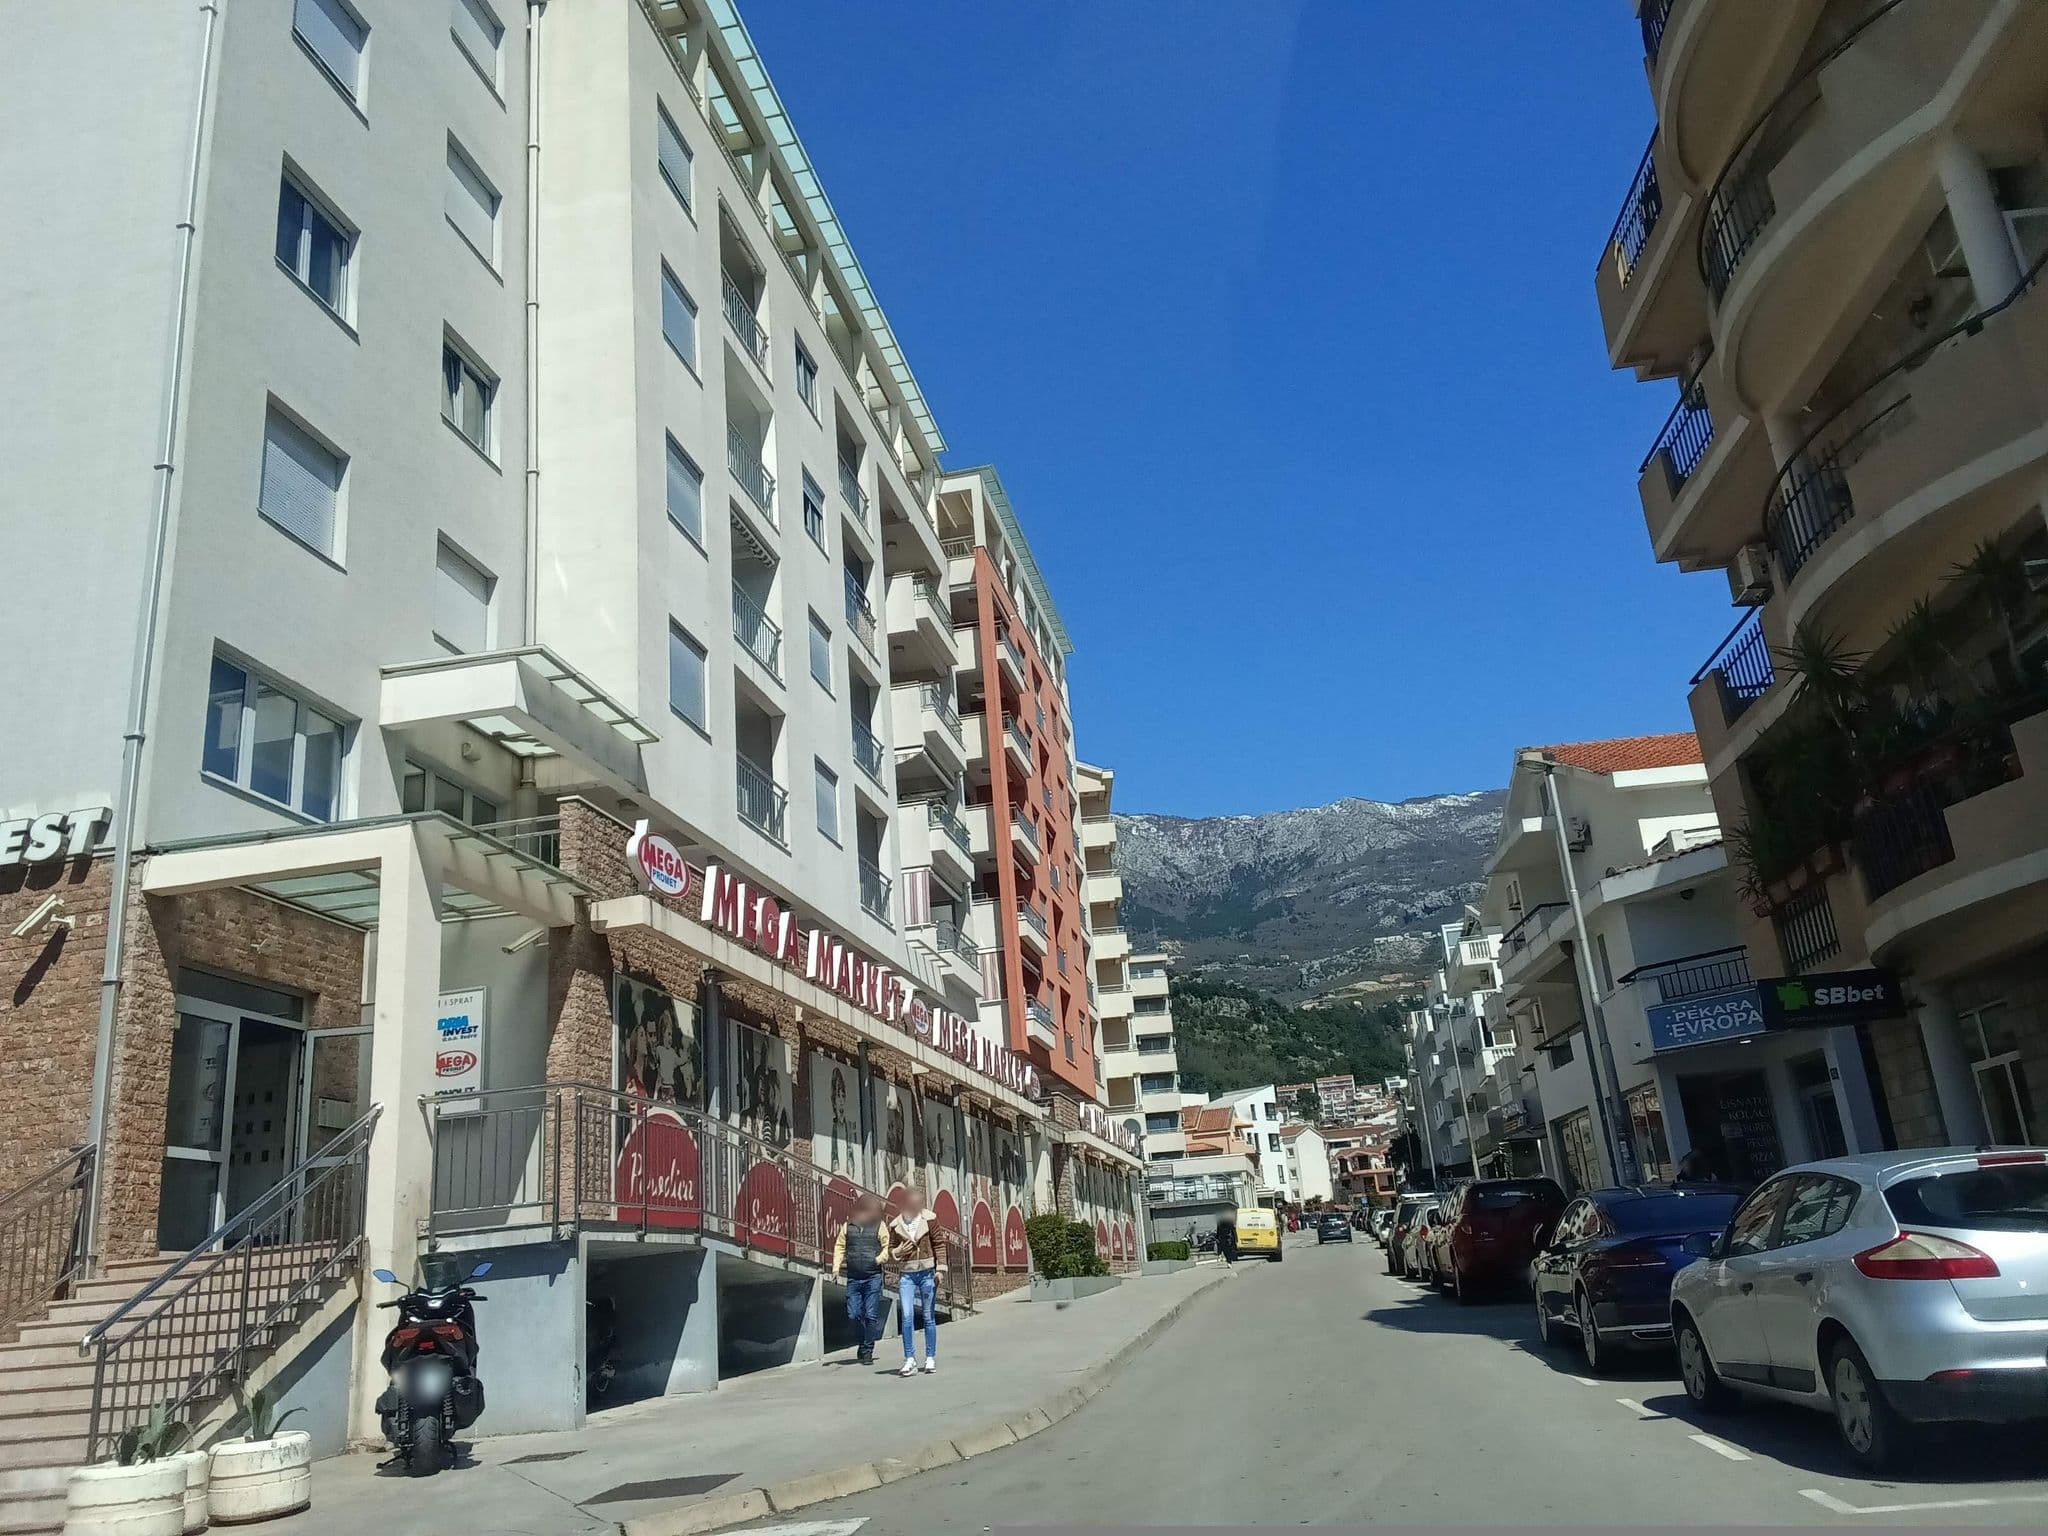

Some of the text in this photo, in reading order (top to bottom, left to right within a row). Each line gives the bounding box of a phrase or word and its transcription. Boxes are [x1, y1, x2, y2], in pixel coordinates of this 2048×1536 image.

[643, 842, 684, 882] MEGA
[652, 868, 678, 889] PROMET
[702, 865, 905, 1022] MEGA MARKET
[1814, 984, 1884, 1006] SBbet
[1671, 1010, 1764, 1038] EVROPA
[1675, 1000, 1754, 1023] PEKARA
[442, 1025, 479, 1037] INVEST
[933, 1008, 978, 1068] MEGA
